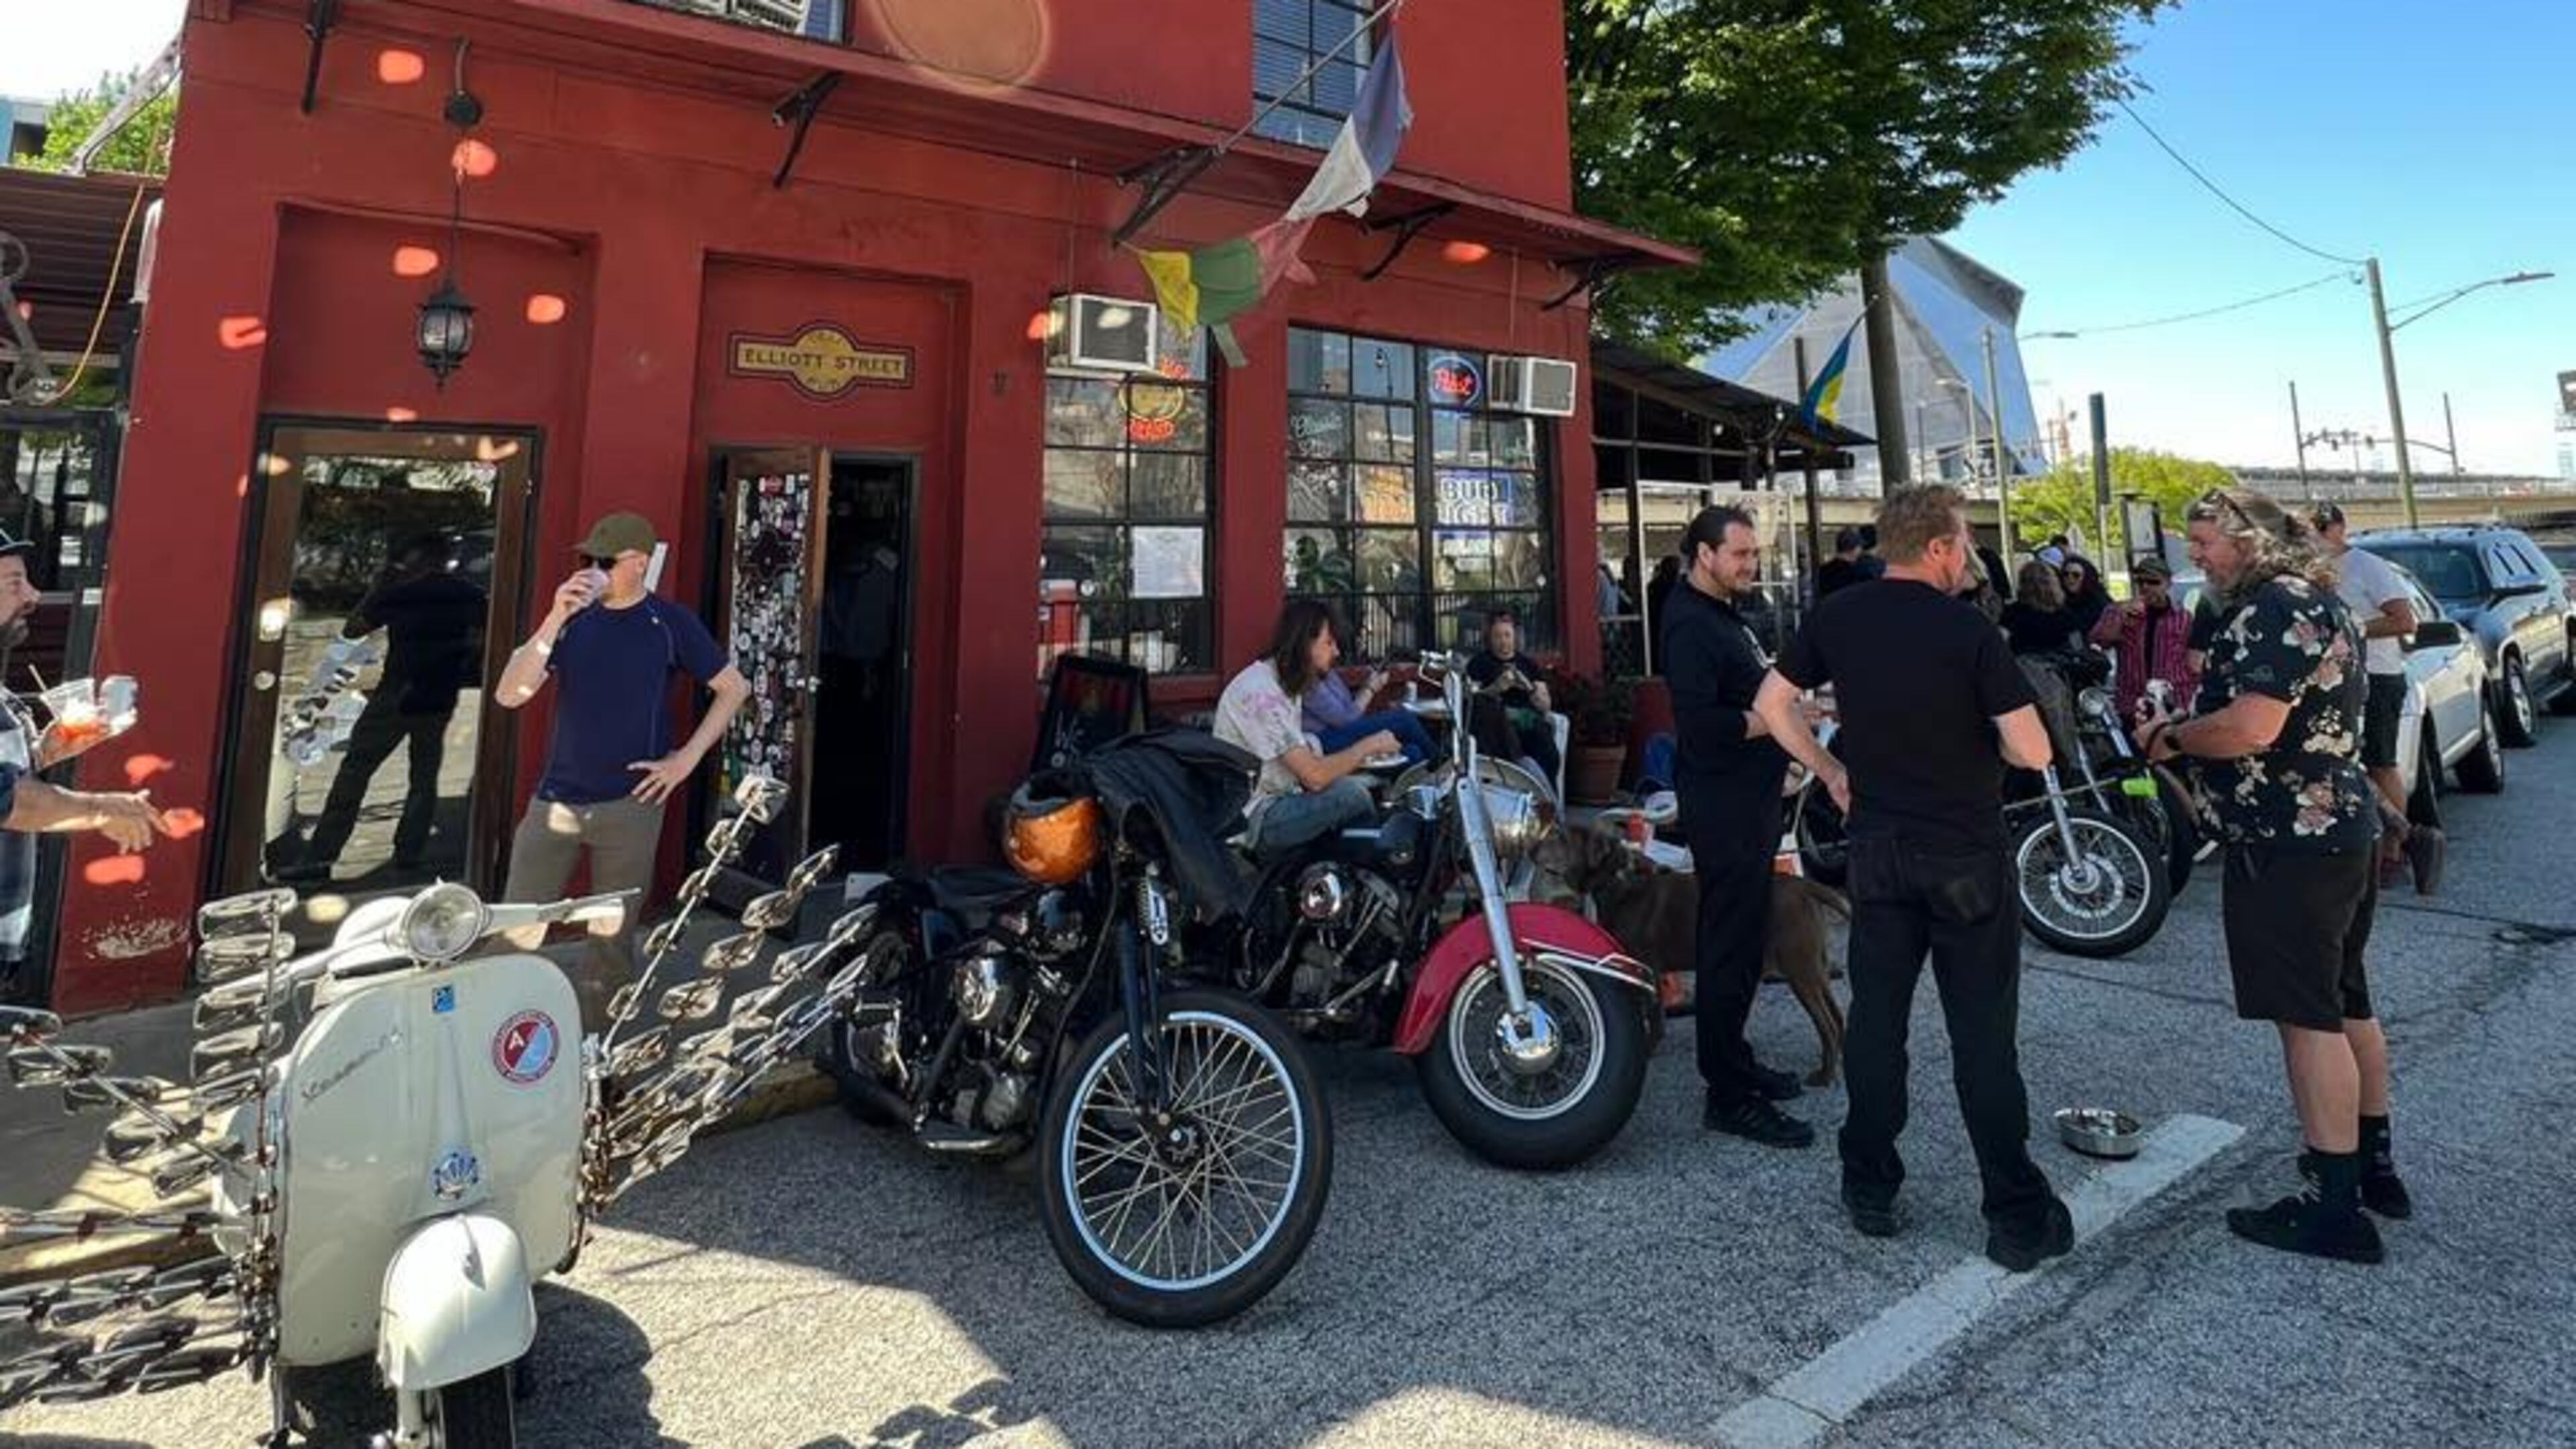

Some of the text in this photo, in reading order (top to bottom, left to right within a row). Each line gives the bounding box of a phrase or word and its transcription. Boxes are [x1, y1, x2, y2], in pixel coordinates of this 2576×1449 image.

[745, 349, 901, 373] ELLIOTT STREET
[1440, 477, 1498, 503] BUD
[1436, 502, 1512, 525] LIGHT
[508, 1030, 524, 1050] A
